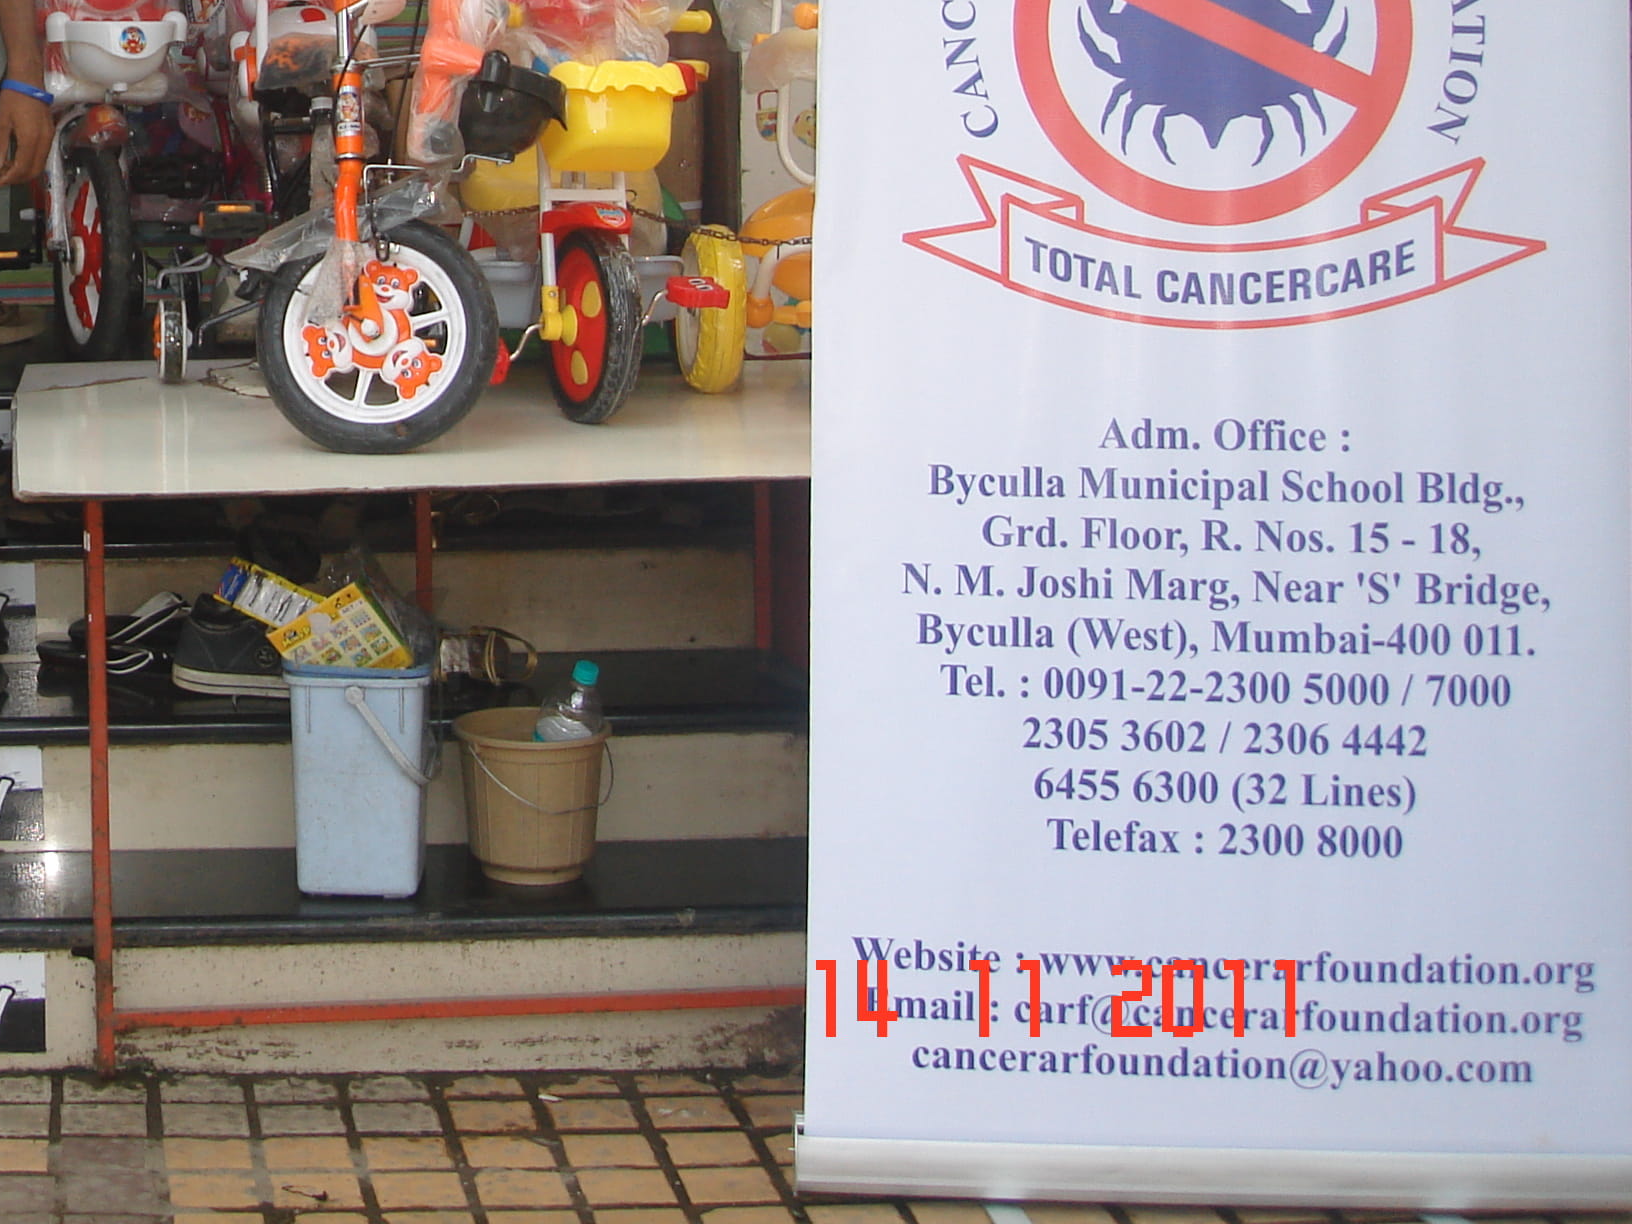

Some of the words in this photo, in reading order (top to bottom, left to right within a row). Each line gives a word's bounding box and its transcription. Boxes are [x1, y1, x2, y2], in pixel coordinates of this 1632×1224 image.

[1025, 236, 1142, 299] TOTAL
[1157, 239, 1415, 305] CANCERCARE
[1099, 418, 1200, 450] Adm.
[1214, 419, 1326, 452] Office
[928, 464, 1066, 505] Byculla
[1078, 467, 1269, 511] Municipal
[1282, 470, 1404, 503] School
[1418, 472, 1524, 513] Bldg.,
[982, 515, 1068, 548] Grd.
[1080, 517, 1188, 557] Floor,
[1201, 520, 1242, 552] R.
[1255, 520, 1334, 553] Nos.
[1350, 522, 1389, 554] 15
[1431, 523, 1481, 561] 18,
[902, 563, 942, 595] N.
[955, 564, 1004, 597] M.
[1017, 566, 1114, 599] Joshi
[1126, 568, 1240, 611] Marg,
[1252, 571, 1344, 603] Near
[1416, 573, 1550, 615] Bridge,
[916, 613, 1055, 655] Byculla
[1068, 617, 1198, 659] (West),
[1211, 621, 1451, 656] Mumbai-400
[1464, 624, 1535, 656] 011.
[940, 664, 1005, 698] Tel.
[1044, 667, 1290, 704] 0091-22-2300
[1304, 673, 1390, 706] 5000
[1426, 674, 1511, 707] 7000
[1023, 717, 1108, 751] 2305
[1121, 720, 1206, 753] 3602
[1244, 722, 1330, 755] 2306
[1342, 724, 1427, 757] 4442
[1034, 767, 1120, 801] 6455
[1133, 770, 1218, 804] 6300
[1232, 773, 1287, 813] (32
[1302, 774, 1416, 815] Lines)
[1047, 818, 1180, 854] Telefax
[1219, 823, 1304, 856] 2300
[1317, 825, 1403, 858] 8000
[852, 936, 1001, 973] Website
[912, 1043, 1533, 1090] cancerarfoundation@yahoo.com
